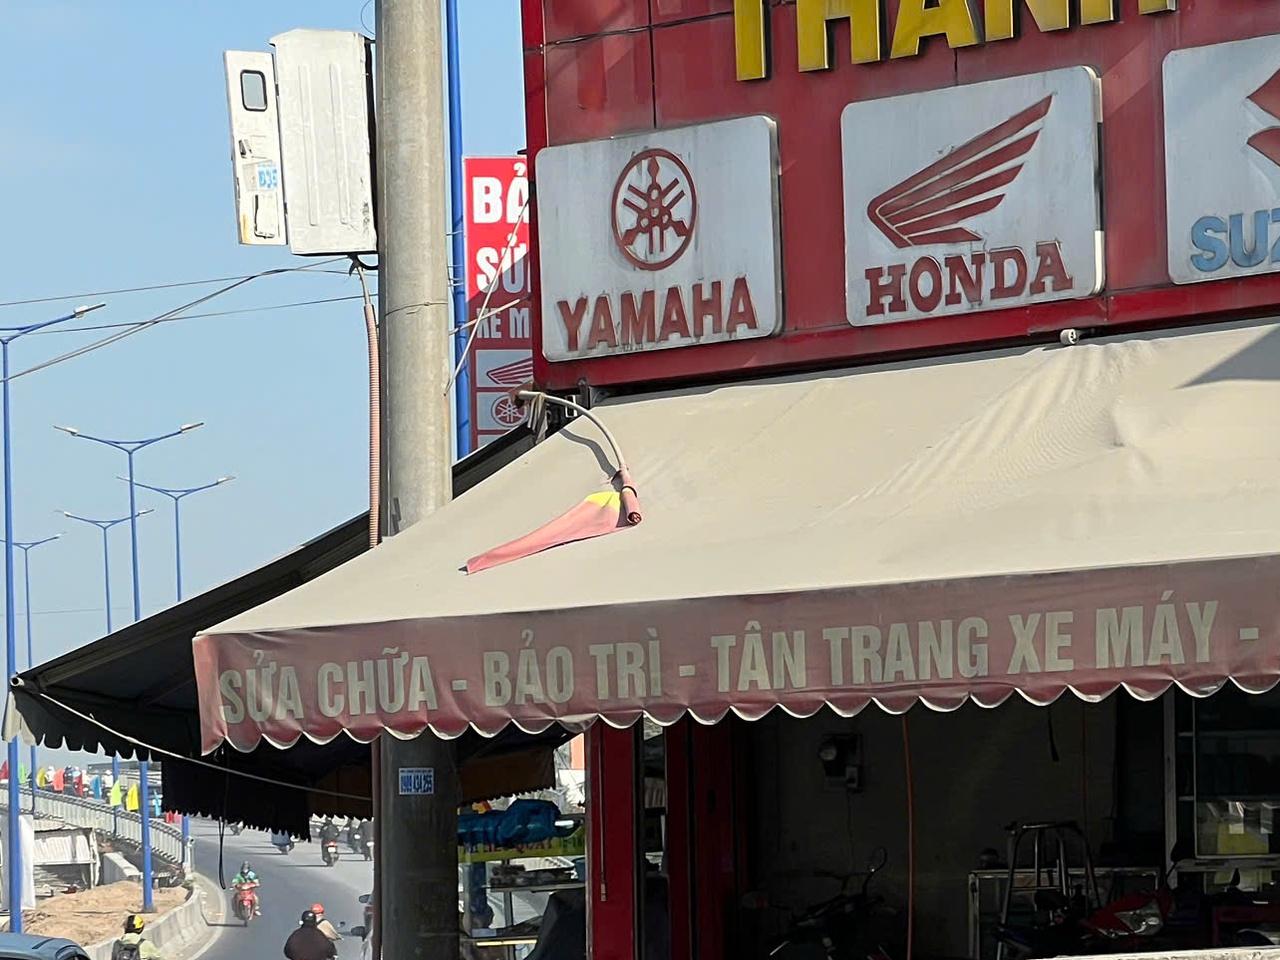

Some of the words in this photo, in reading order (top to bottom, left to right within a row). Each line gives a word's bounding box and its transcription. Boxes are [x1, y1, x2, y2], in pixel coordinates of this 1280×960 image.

[475, 234, 530, 294] SỬ
[865, 241, 1073, 316] HONDA
[556, 276, 759, 351] YAMAHA
[220, 650, 303, 725] SỬA
[317, 647, 437, 718] CHỮA
[483, 629, 574, 707] BẢO
[590, 627, 663, 700] TRÌ
[710, 622, 806, 692] TÂN
[823, 615, 988, 686] TRANG
[1007, 611, 1074, 675] XE
[1095, 571, 1219, 669] MÁY
